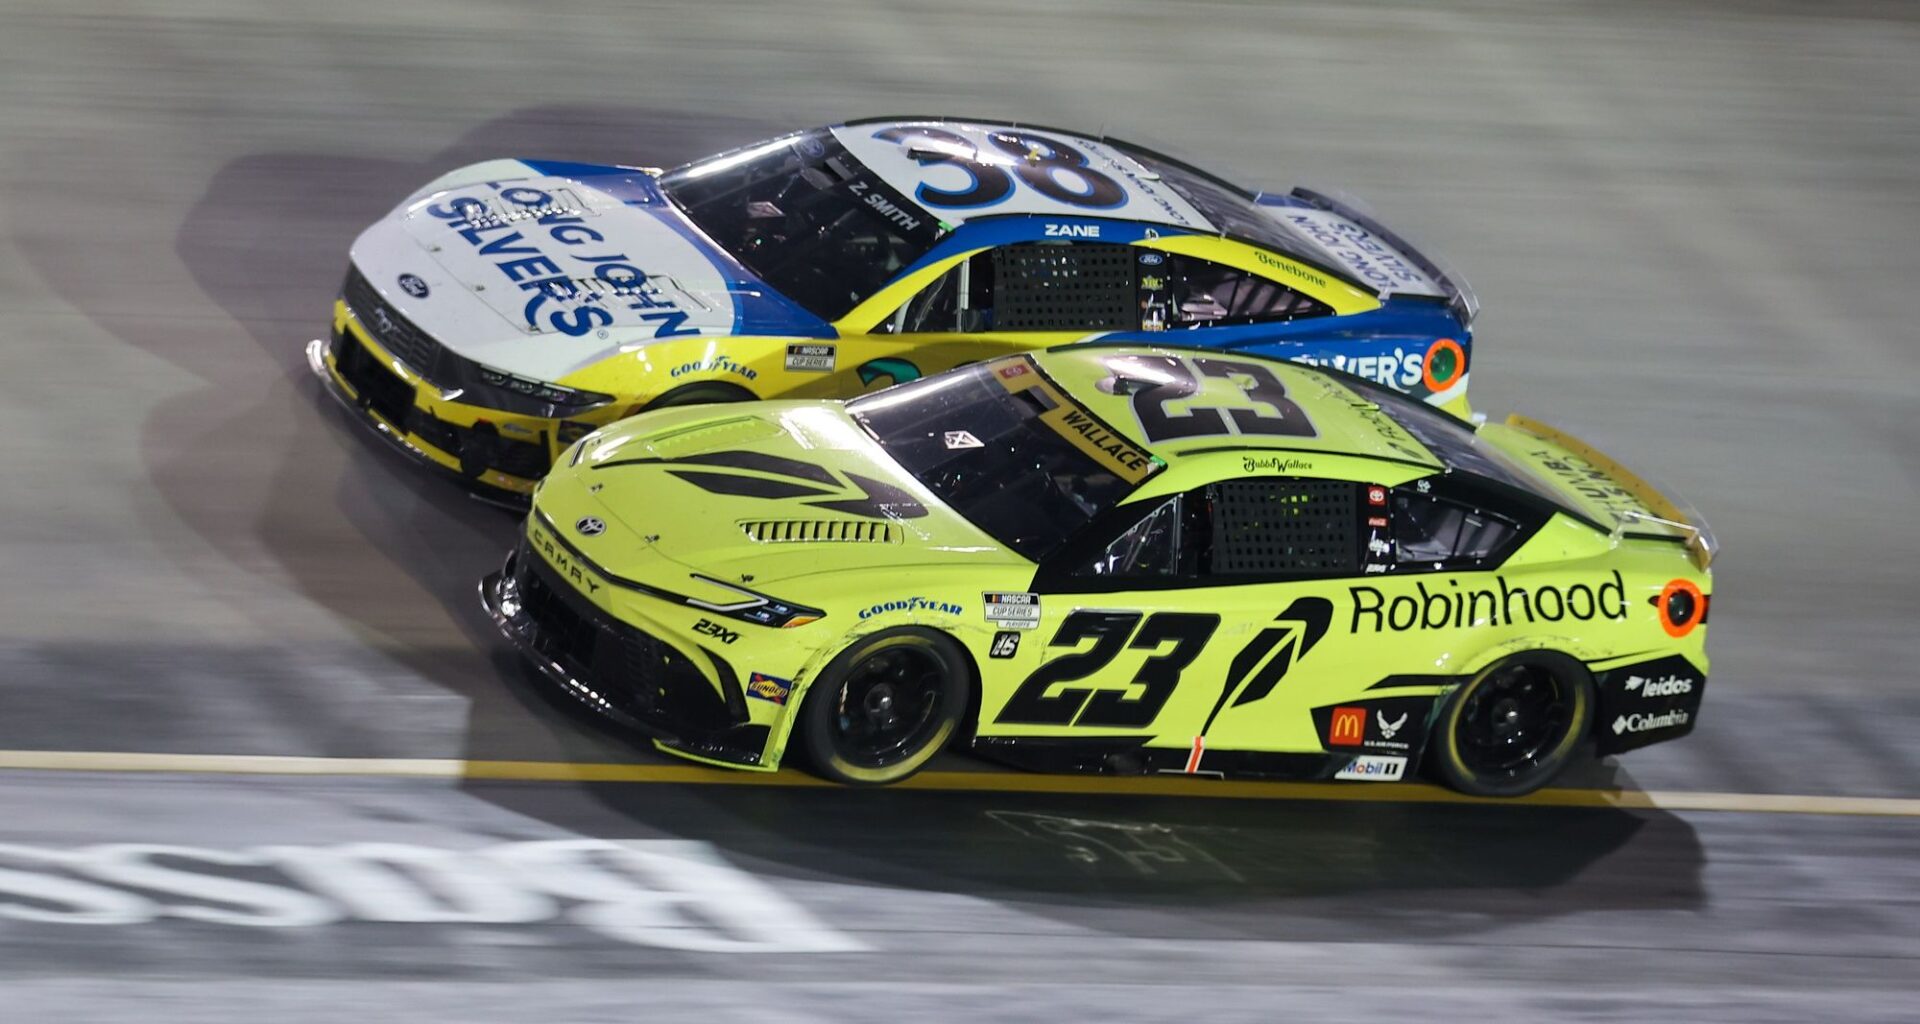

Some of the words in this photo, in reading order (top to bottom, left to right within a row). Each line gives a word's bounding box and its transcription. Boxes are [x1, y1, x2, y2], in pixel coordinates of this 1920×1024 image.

[871, 126, 1129, 210] 38
[848, 181, 869, 197] Z.
[863, 193, 921, 231] SMITH
[1045, 223, 1100, 238] ZANE
[1254, 251, 1327, 288] Benebone
[570, 253, 702, 338] JOHN
[802, 345, 828, 355] NASCAR
[805, 357, 827, 367] SERIES
[1095, 355, 1318, 443] 23
[1062, 410, 1149, 471] WALLACE
[1272, 457, 1312, 473] Wallace
[534, 529, 600, 594] CAMRY
[858, 597, 963, 619] GOODYEAR
[1002, 594, 1031, 605] NASCAR
[1349, 570, 1628, 634] Robinhood
[993, 606, 1007, 616] CUP
[1007, 607, 1033, 618] SERIES
[691, 617, 743, 645] 23XI
[991, 633, 1019, 656] 16
[992, 611, 1221, 729] 23
[750, 681, 788, 698] SUNOCO
[1641, 674, 1693, 698] leidos
[1626, 708, 1689, 732] Columbia
